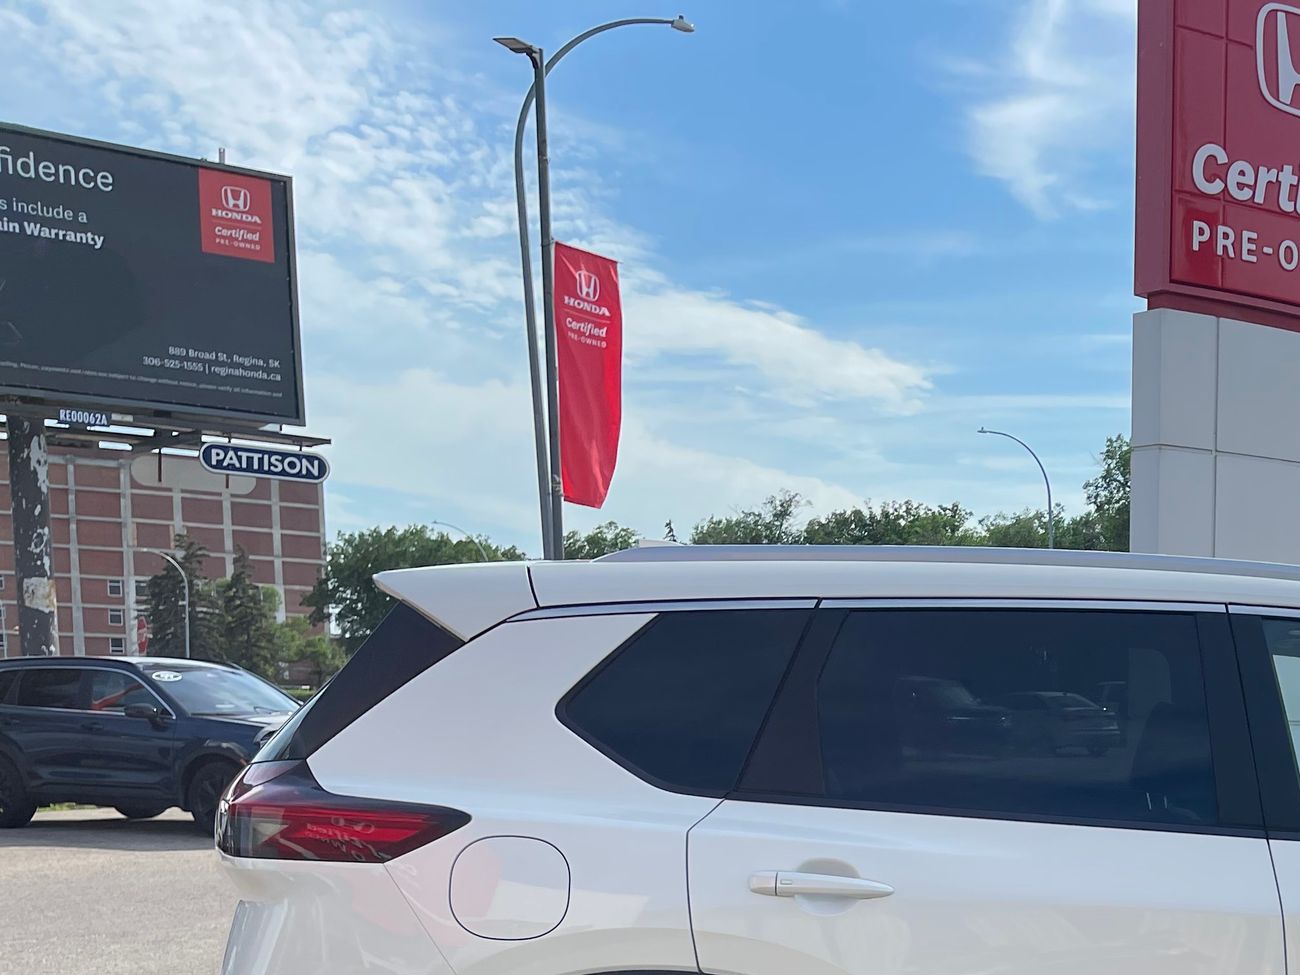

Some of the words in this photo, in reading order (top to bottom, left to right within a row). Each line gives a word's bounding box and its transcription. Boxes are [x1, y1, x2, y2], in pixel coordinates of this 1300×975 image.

[12, 197, 74, 221] include
[78, 211, 88, 223] a
[211, 208, 262, 224] HONDA
[23, 221, 105, 249] Warranty
[215, 226, 260, 242] Certified
[563, 295, 611, 317] HONDA
[566, 317, 608, 338] Certified
[188, 348, 216, 360] Broad
[233, 354, 267, 367] Regina,
[268, 359, 281, 368] SK
[210, 365, 281, 381] reginahonda.ca
[59, 409, 108, 426] RE00062A
[210, 448, 321, 477] PATTISON
